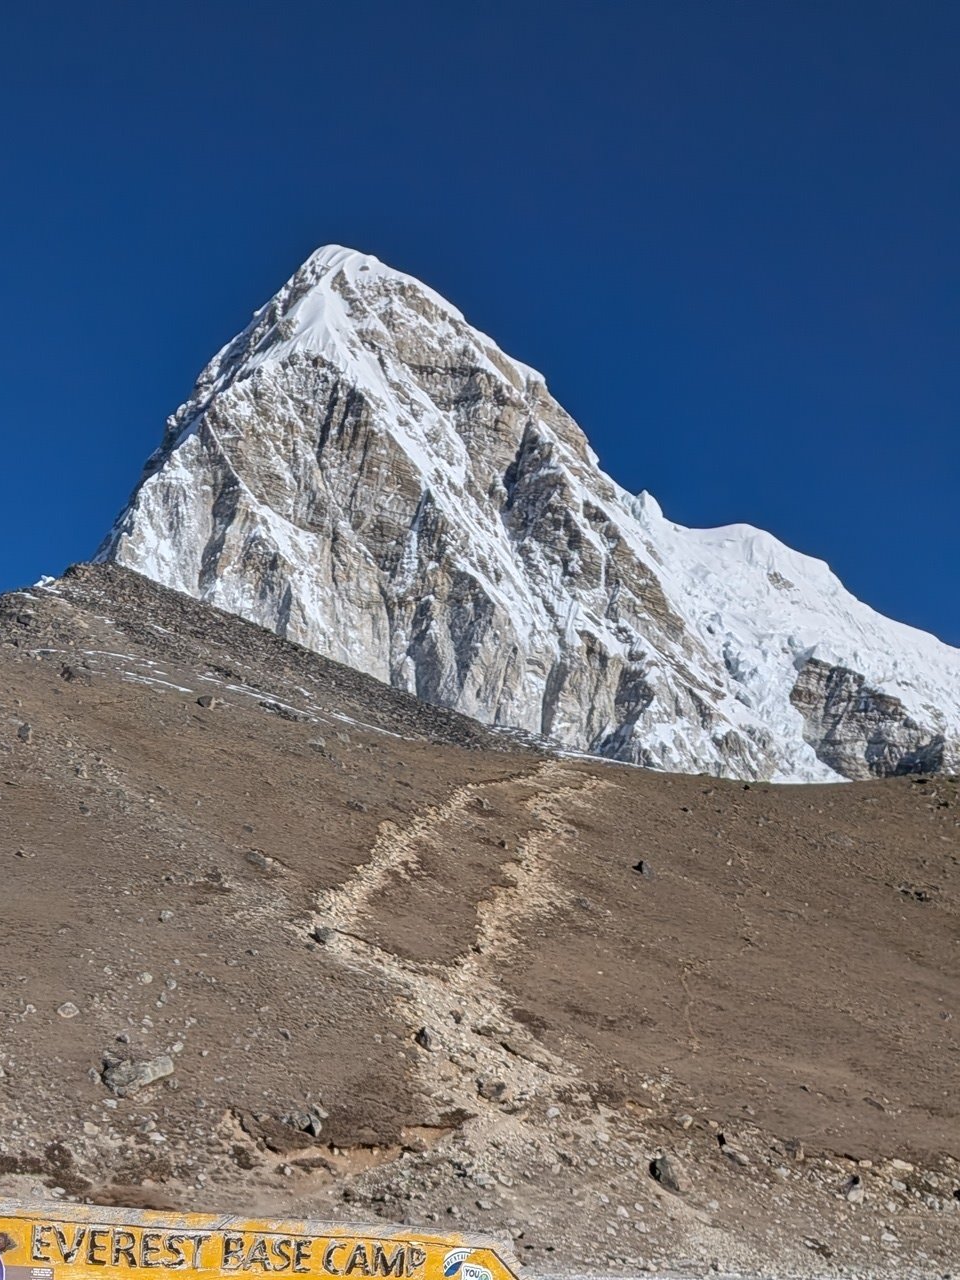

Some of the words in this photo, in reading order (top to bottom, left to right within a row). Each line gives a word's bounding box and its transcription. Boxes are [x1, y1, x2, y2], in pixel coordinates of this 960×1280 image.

[31, 1223, 212, 1270] EVEREST
[221, 1230, 313, 1274] BASE
[322, 1237, 427, 1279] CAMP
[464, 1268, 481, 1279] YOU
